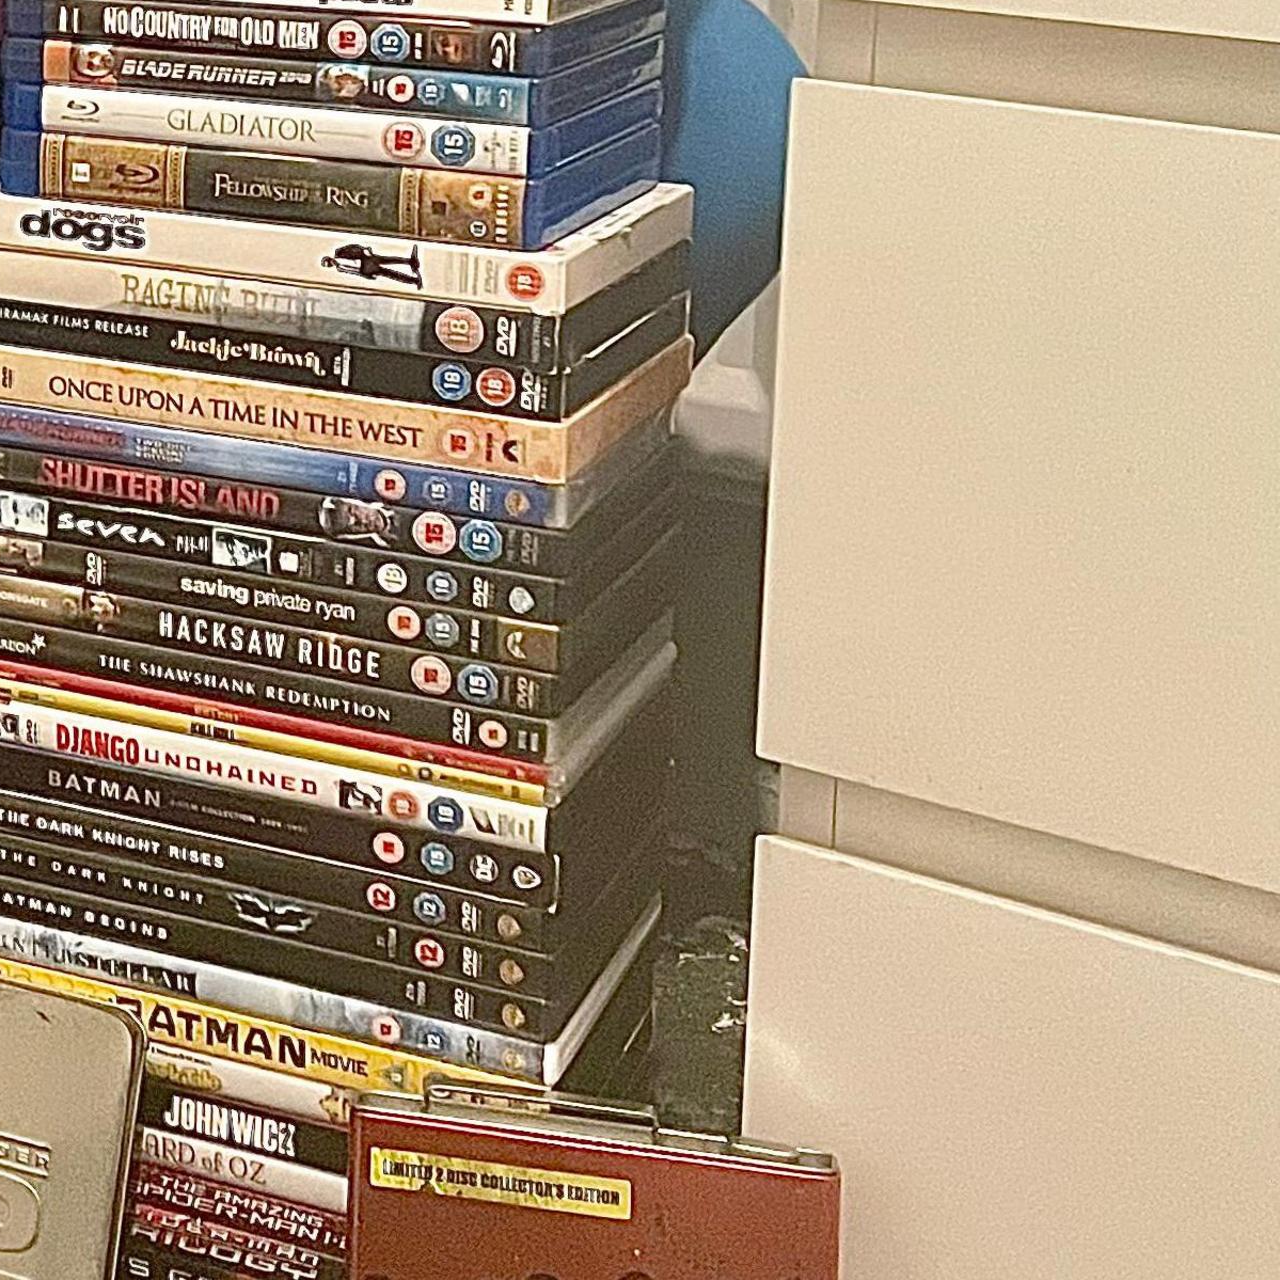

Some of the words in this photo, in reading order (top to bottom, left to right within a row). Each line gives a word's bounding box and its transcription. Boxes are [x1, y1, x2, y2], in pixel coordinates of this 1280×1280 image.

[103, 5, 128, 34] NO
[130, 5, 212, 40] COUNTRY
[214, 16, 239, 38] FOR
[241, 17, 275, 46] OLD
[279, 20, 320, 49] MEN
[339, 30, 356, 49] 15
[382, 35, 399, 53] 15
[121, 59, 185, 79] BLADE
[186, 63, 278, 87] RUNNER
[167, 108, 317, 143] GLADIATOR
[394, 129, 414, 151] 15
[443, 133, 465, 156] 15
[214, 172, 309, 203] FELLOWSHIP
[326, 186, 369, 209] RING
[20, 209, 146, 252] dogs
[120, 273, 230, 315] RAGING
[53, 314, 90, 330] FILMS
[95, 319, 150, 338] RELEASE
[449, 319, 470, 342] 18
[496, 316, 510, 356] DVD
[443, 370, 460, 389] 18
[487, 377, 503, 395] 18
[48, 375, 113, 403] ONCE
[119, 384, 184, 415] UPON
[189, 396, 205, 417] A
[208, 398, 266, 426] TIME
[272, 407, 299, 430] IN
[304, 412, 352, 439] THE
[357, 419, 424, 448] WEST
[39, 458, 163, 506] SHUTTER
[170, 476, 281, 519] ISLAND
[431, 481, 445, 499] 15
[57, 511, 166, 547] seven
[425, 522, 444, 543] 15
[472, 530, 490, 551] 15
[181, 574, 249, 605] saving
[254, 586, 311, 613] private
[315, 598, 355, 621] ryan
[159, 611, 286, 659] HACKSAW
[297, 636, 381, 678] RIDGE
[98, 654, 131, 673] THE
[140, 661, 256, 696] SHAWSHANK
[265, 684, 391, 722] REDEMPTION
[56, 723, 140, 765] DJANGO
[47, 769, 162, 808] BATMAN
[36, 817, 85, 839] DARK
[92, 829, 161, 854] KNIGHT
[169, 844, 225, 869] RISES
[0, 849, 37, 867] THE
[51, 861, 107, 884] DARK
[123, 876, 205, 905] KNIGHT
[372, 887, 390, 907] 12
[84, 911, 168, 941] BEGINS
[420, 943, 438, 962] 12
[310, 1048, 369, 1078] MOVIE
[164, 1094, 231, 1141] JOHN
[201, 1152, 225, 1173] of
[228, 1156, 268, 1185] OZ
[382, 1158, 433, 1181] LIMITED
[436, 1166, 444, 1182] 2
[447, 1169, 478, 1187] DISC
[480, 1173, 564, 1200] COLLECTOR'S
[567, 1184, 620, 1206] EDITION
[160, 1174, 207, 1196] THE
[214, 1190, 324, 1229] AMAZING
